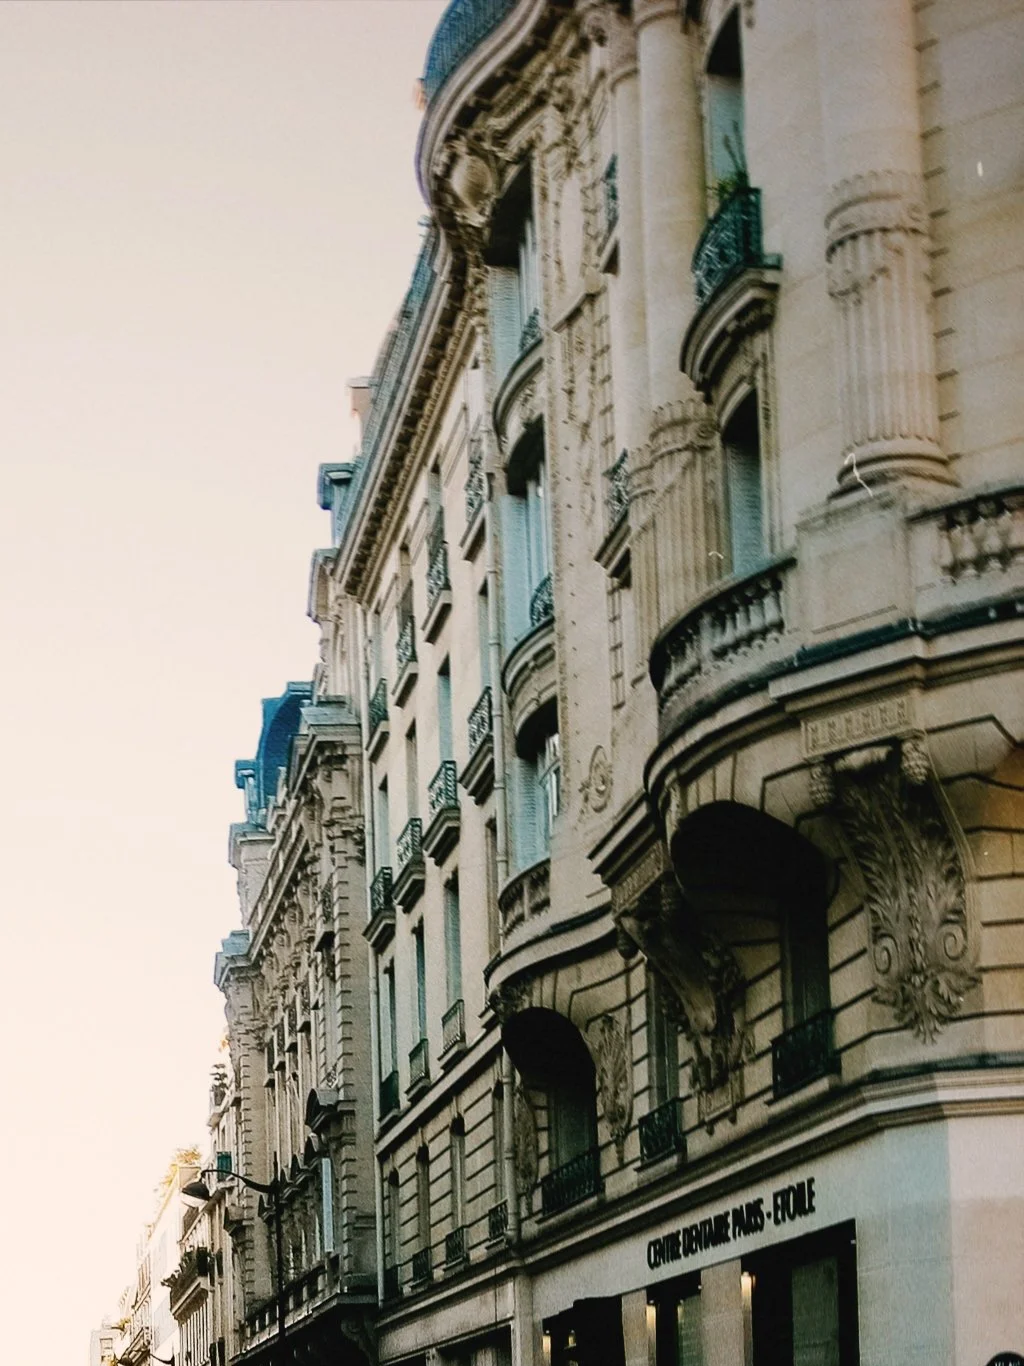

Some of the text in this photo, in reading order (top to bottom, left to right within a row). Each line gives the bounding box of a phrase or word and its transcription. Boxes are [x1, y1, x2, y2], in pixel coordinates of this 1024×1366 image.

[647, 1230, 681, 1269] CENTRE
[682, 1211, 731, 1257] DENTAIRE
[732, 1198, 764, 1241] PARIS
